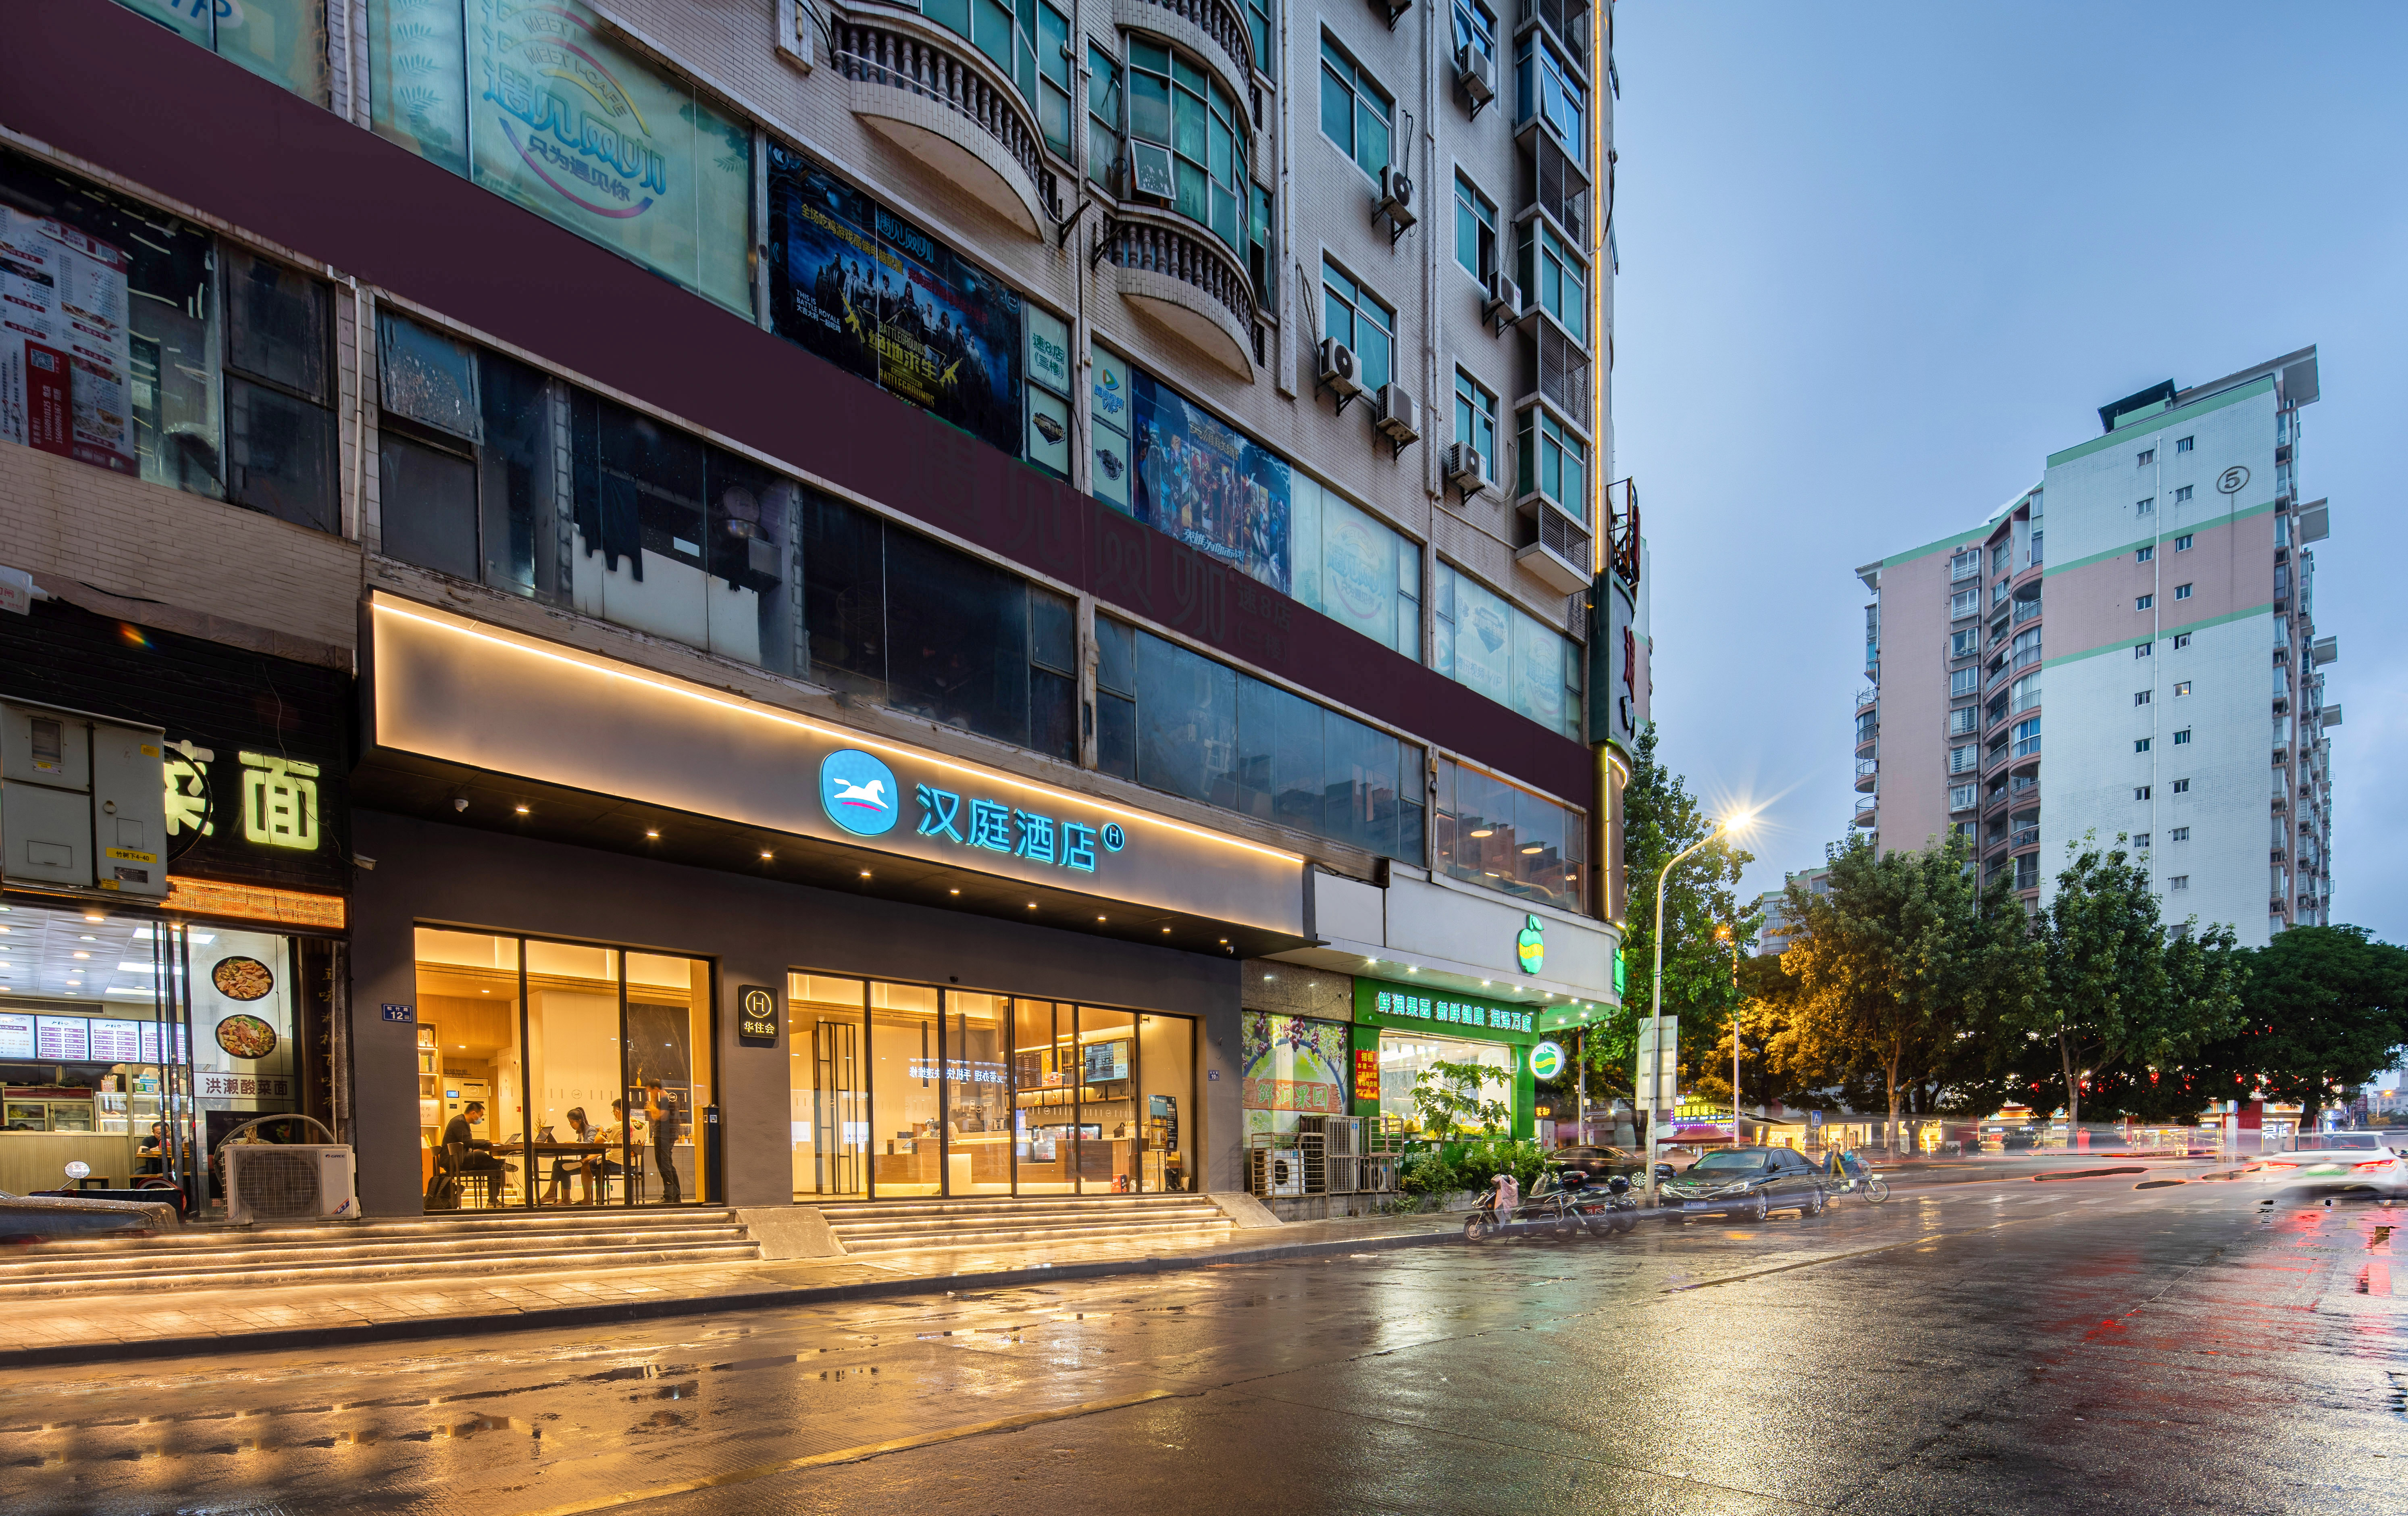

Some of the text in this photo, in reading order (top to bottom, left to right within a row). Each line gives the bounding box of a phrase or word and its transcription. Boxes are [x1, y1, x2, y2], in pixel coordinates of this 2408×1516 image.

[483, 54, 666, 195] 遇见网咖
[528, 135, 631, 202] 只为遇见你
[801, 203, 903, 275] 全场吃鸡游戏高端电脑配置
[797, 289, 816, 305] THIS IS
[797, 296, 840, 325] BATTLE ROYALE
[797, 304, 841, 333] 大吉大利 一起吃鸡
[879, 321, 926, 357] BATTLEGROUNDS
[1032, 333, 1064, 364] 速8店
[868, 327, 938, 383] 绝地求生
[879, 368, 935, 408] BATTLEGROUNDS
[1094, 384, 1124, 409] 腾讯视频
[1102, 398, 1118, 414] VIP
[1189, 422, 1239, 461] 英雄联盟
[1194, 438, 1210, 451] LEAGUE
[916, 782, 1097, 873] 汉庭酒店
[116, 851, 149, 861] 竹树下4-40
[391, 1011, 403, 1019] 12
[1379, 992, 1532, 1033] 鲜润果园 新鲜健康 润泽万家
[744, 1021, 775, 1034] 华住会
[1361, 1052, 1374, 1062] 招租
[1536, 1058, 1556, 1068] XIANRUN
[206, 1078, 287, 1095] 洪濑酸菜面
[1257, 1082, 1328, 1111] 鲜润果园
